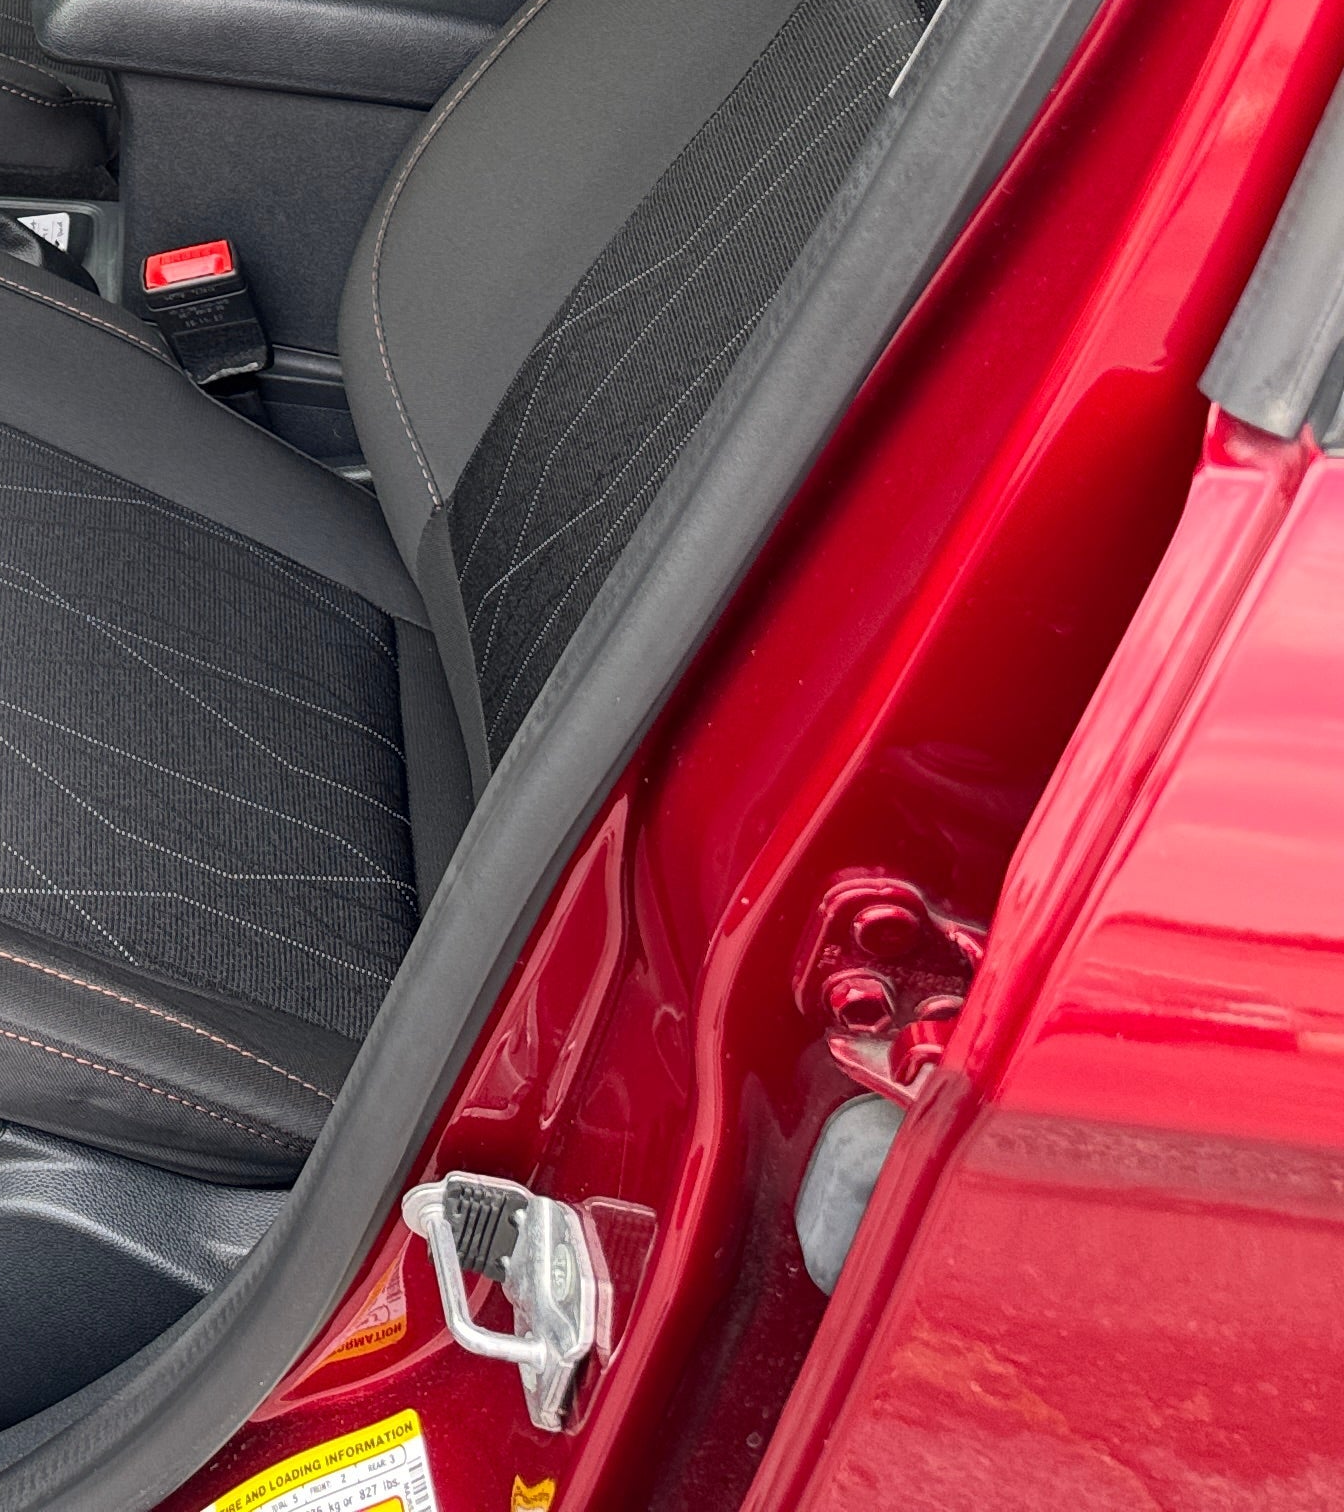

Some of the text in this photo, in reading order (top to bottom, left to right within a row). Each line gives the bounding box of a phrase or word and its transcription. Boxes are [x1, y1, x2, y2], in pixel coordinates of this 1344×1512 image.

[245, 1484, 266, 1506] AND
[268, 1459, 322, 1491] LOADING
[325, 1420, 413, 1470] INFORMATION
[292, 1494, 299, 1504] 5
[341, 1473, 347, 1484] 2
[389, 1454, 396, 1463] 3
[359, 1483, 378, 1501] 827
